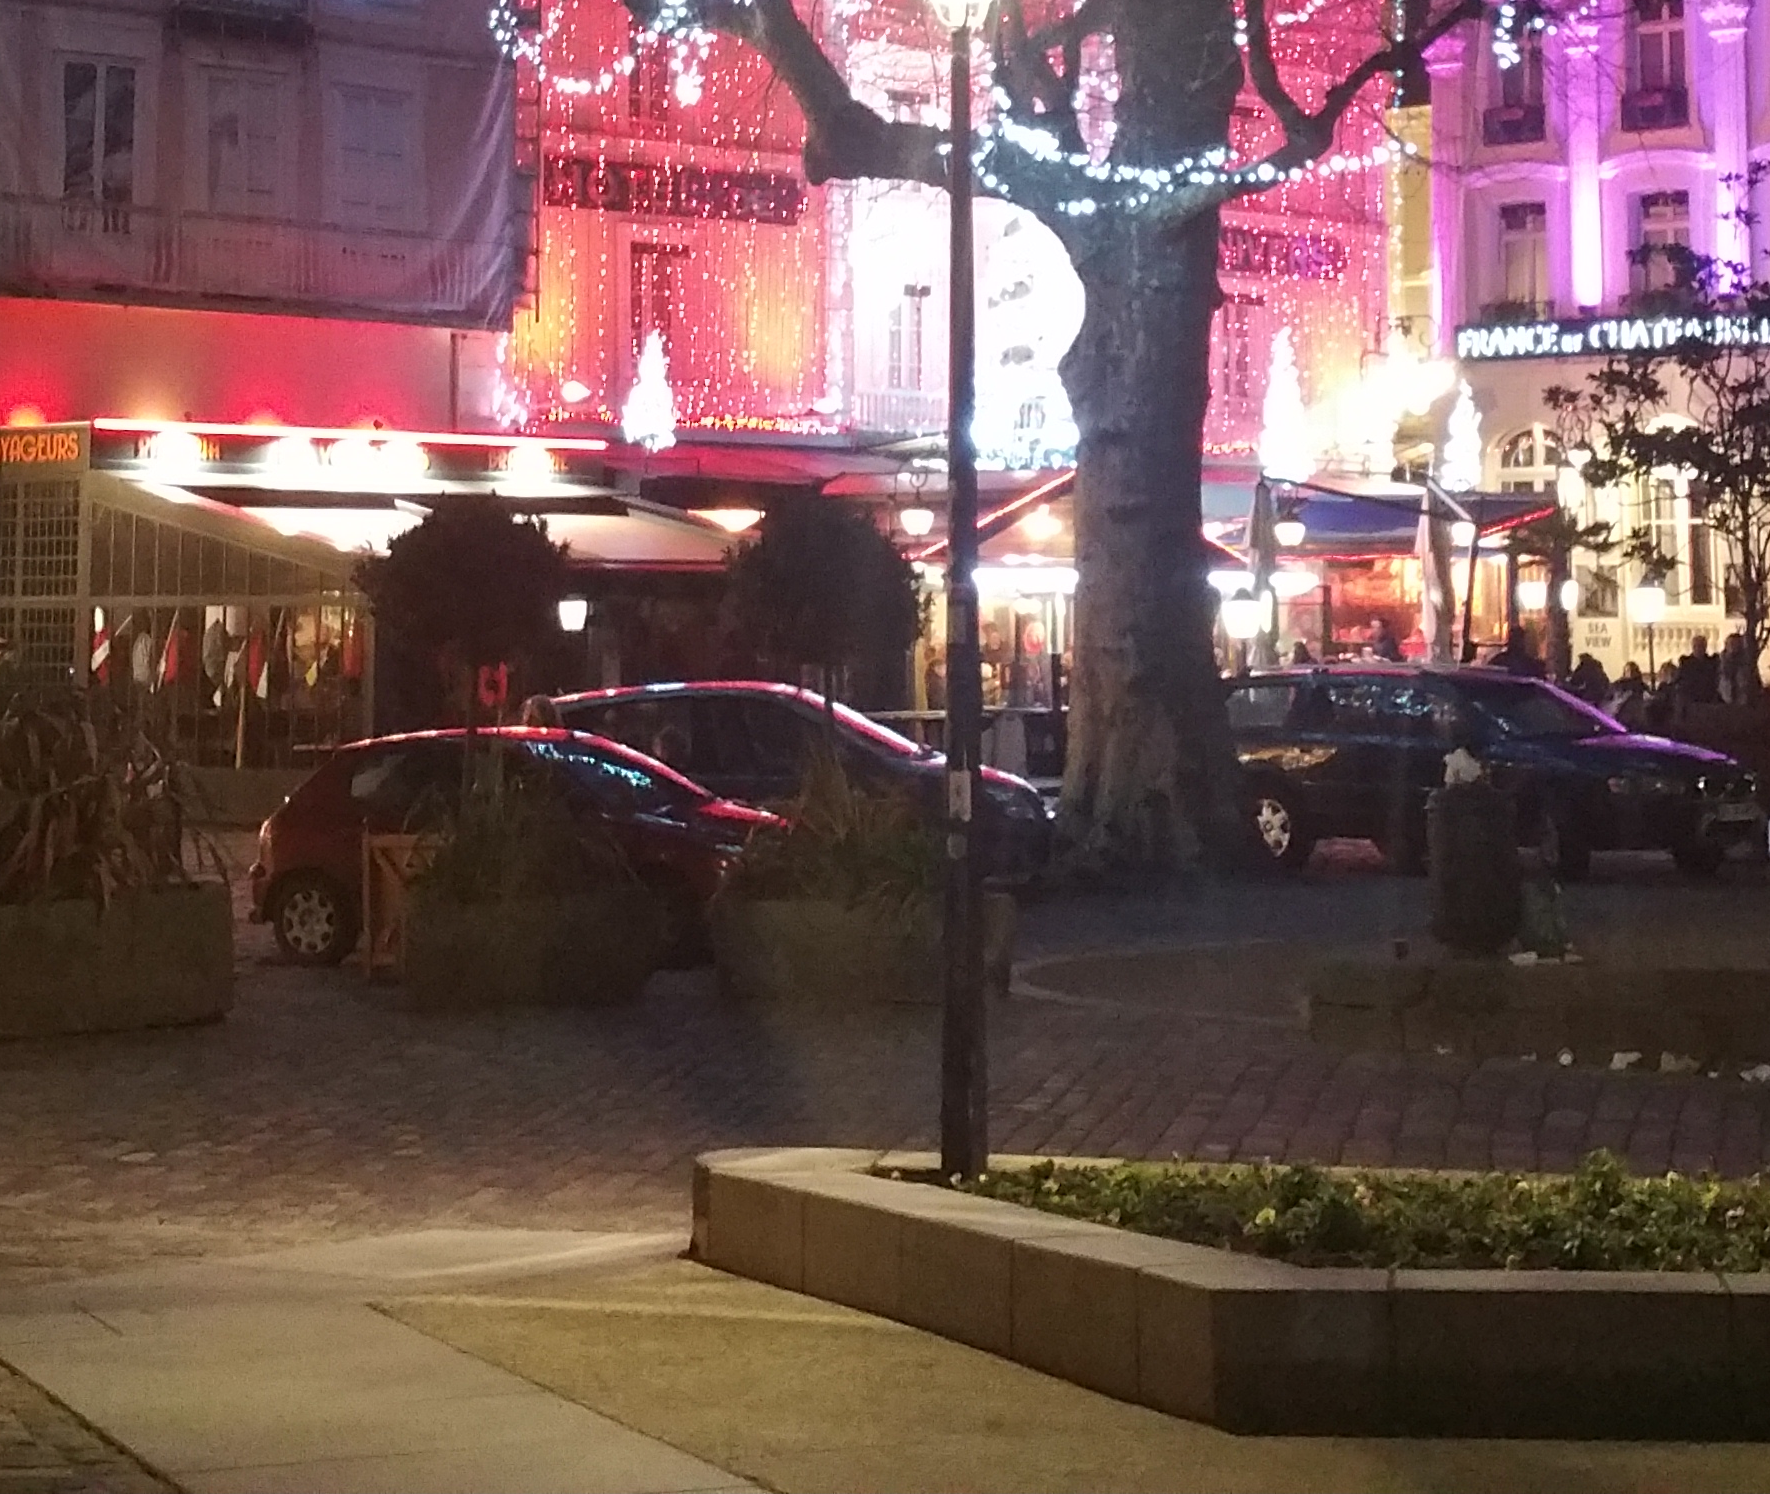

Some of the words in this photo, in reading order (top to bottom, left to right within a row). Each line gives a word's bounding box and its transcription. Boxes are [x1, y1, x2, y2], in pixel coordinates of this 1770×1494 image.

[1218, 230, 1329, 277] NIVERS
[1457, 323, 1560, 357] FRANCE
[1587, 621, 1609, 635] SEA
[1585, 636, 1612, 648] VIEW
